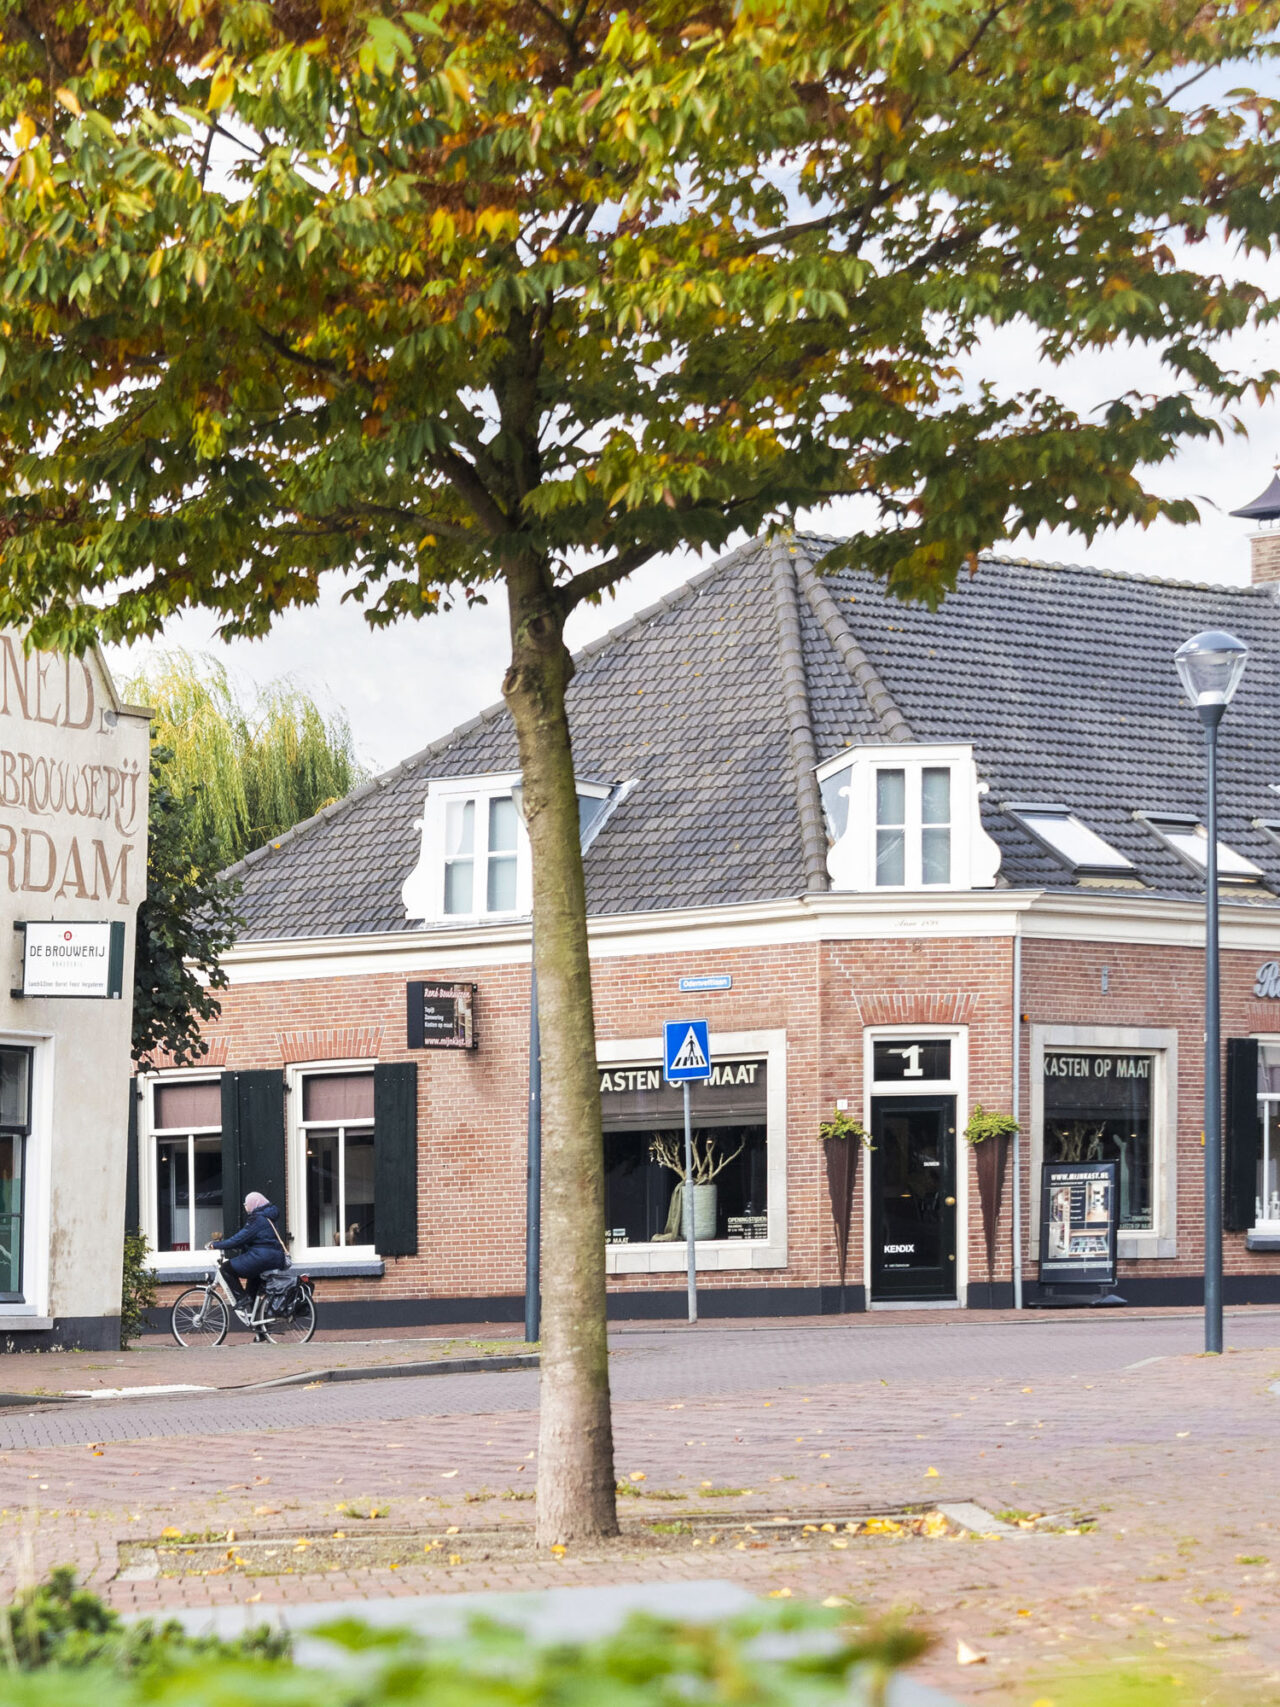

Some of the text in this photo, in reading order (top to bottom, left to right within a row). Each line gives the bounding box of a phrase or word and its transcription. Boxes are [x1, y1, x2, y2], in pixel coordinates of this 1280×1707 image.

[29, 945, 106, 957] DE BROUWERIJ
[902, 1045, 923, 1077] 1
[1043, 1057, 1150, 1078] KASTEN OP MAAT
[599, 1070, 660, 1092] ASTEN
[703, 1064, 759, 1087] MAAT
[884, 1244, 915, 1254] KENDIX
